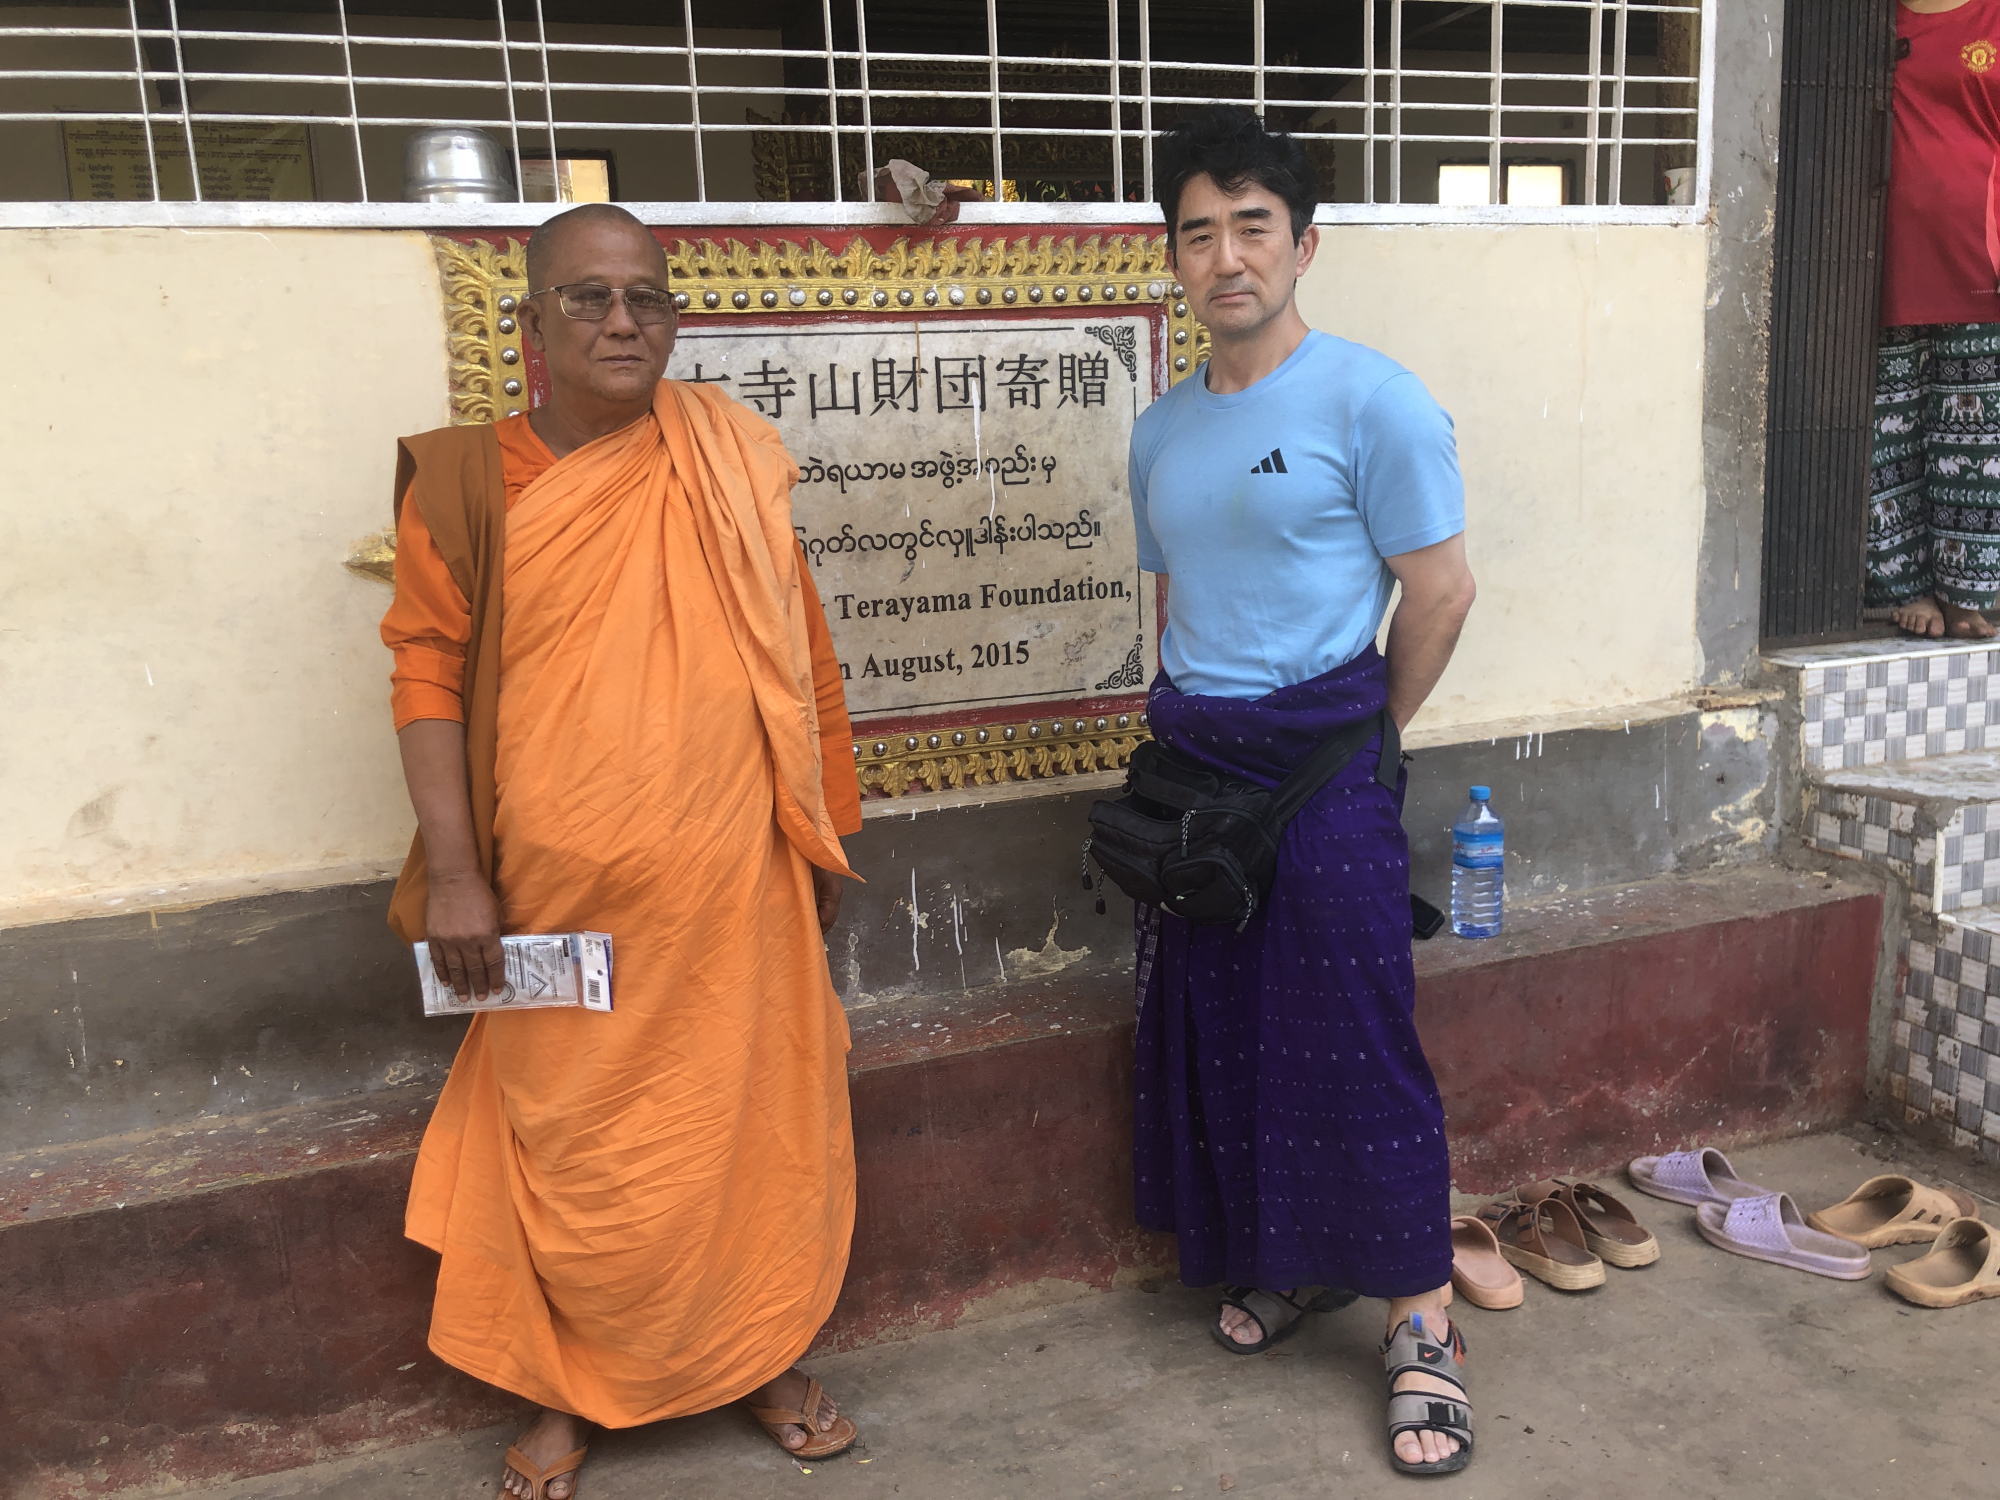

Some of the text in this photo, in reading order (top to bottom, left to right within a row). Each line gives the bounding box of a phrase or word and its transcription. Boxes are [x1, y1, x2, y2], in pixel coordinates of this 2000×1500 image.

[680, 350, 1109, 419] 寺山財団寄贈
[834, 592, 971, 622] Terayama
[980, 576, 1132, 609] Foundation,
[861, 647, 963, 682] August,
[971, 640, 1029, 668] 2015
